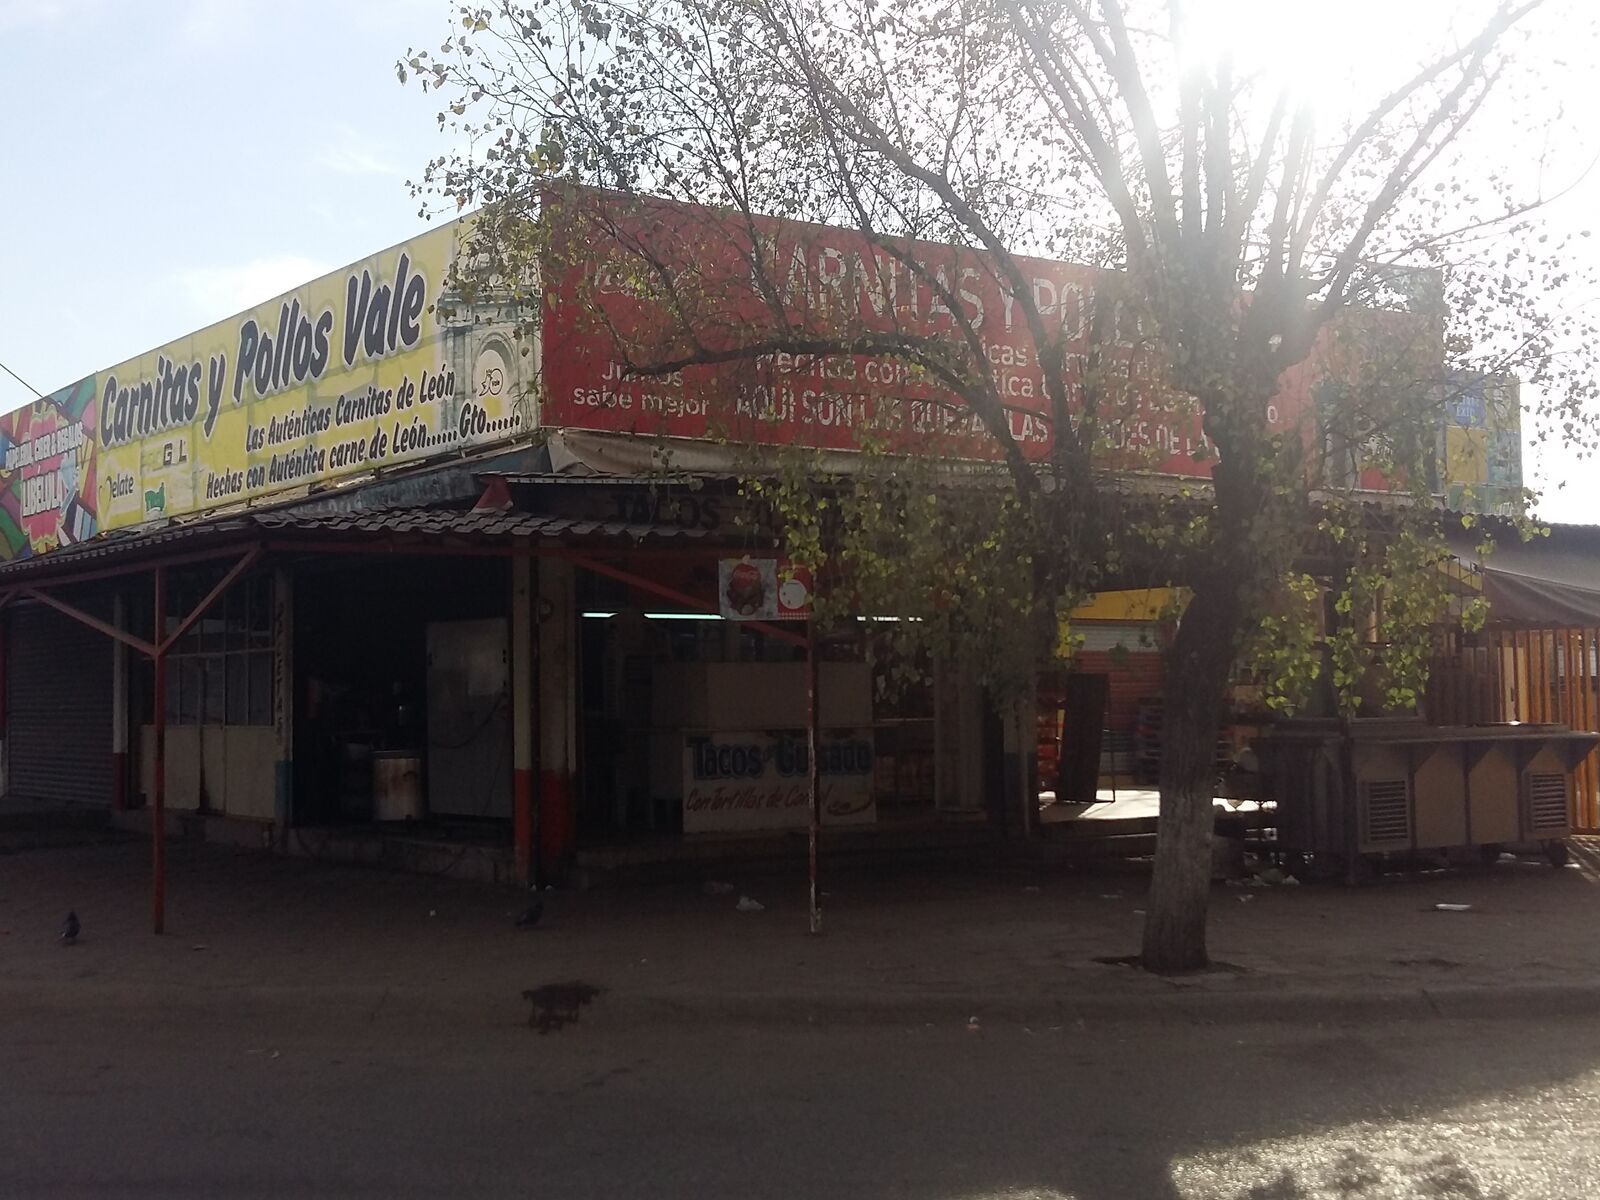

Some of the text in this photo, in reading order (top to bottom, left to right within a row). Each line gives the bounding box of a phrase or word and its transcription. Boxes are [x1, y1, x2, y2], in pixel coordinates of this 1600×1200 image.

[101, 253, 425, 448] Carnitas y Pollos Vale
[246, 363, 455, 452] Las Auténticas Carnitas de León
[573, 385, 710, 418] sabe mejor
[802, 390, 852, 428] SON
[206, 467, 243, 499] Hechas
[246, 467, 265, 490] con
[268, 447, 326, 484] Auténtica
[329, 439, 365, 470] carne
[369, 427, 387, 459] de
[607, 493, 721, 530] TACOS
[686, 736, 763, 780] Tacos
[774, 738, 874, 778] Gusado
[686, 787, 711, 812] Con
[766, 786, 784, 809] de
